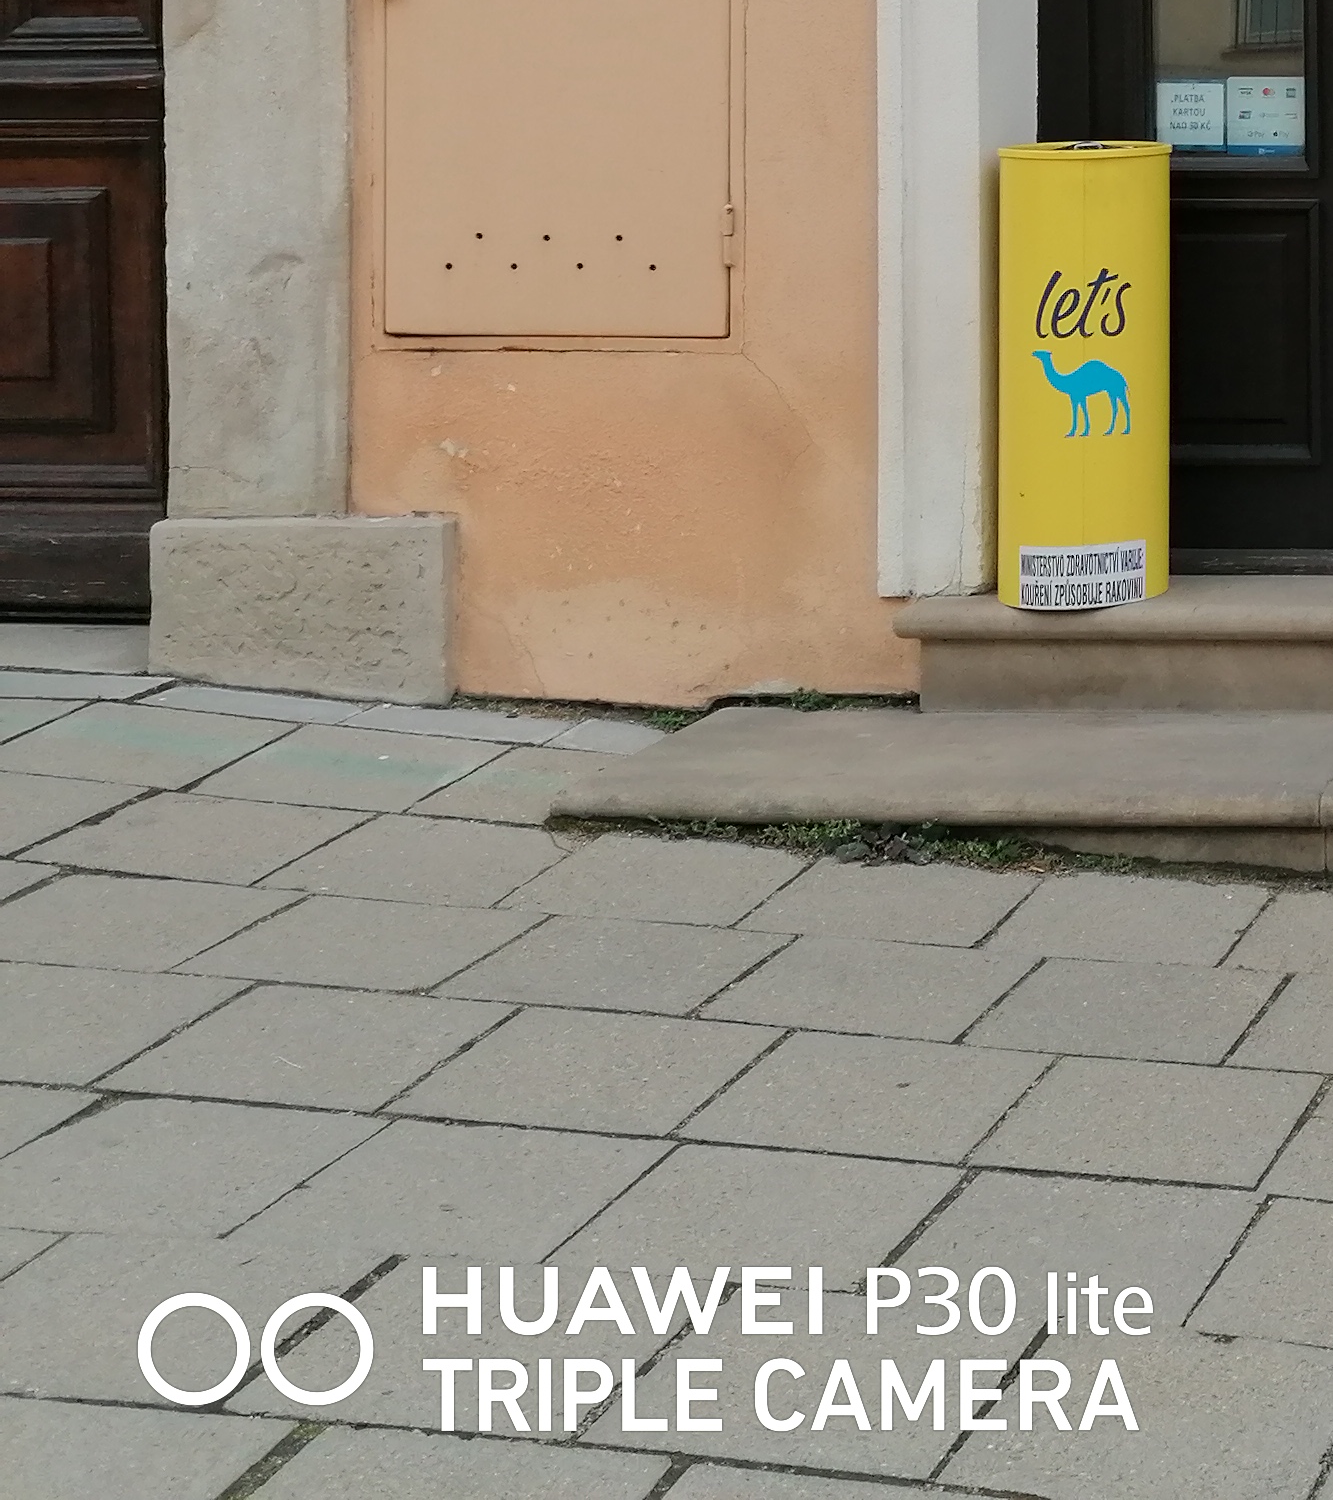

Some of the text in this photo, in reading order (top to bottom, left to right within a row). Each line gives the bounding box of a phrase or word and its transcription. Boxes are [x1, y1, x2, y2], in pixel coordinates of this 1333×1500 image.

[1172, 108, 1206, 117] KARTOU
[1035, 268, 1132, 339] let's
[1021, 554, 1065, 578] MINISTERSTVO
[1066, 547, 1119, 577] ZDRAVOTNICTVÍ
[1021, 577, 1144, 607] KOUŘENÍ ZPŮSOBUJE RAKOVINU
